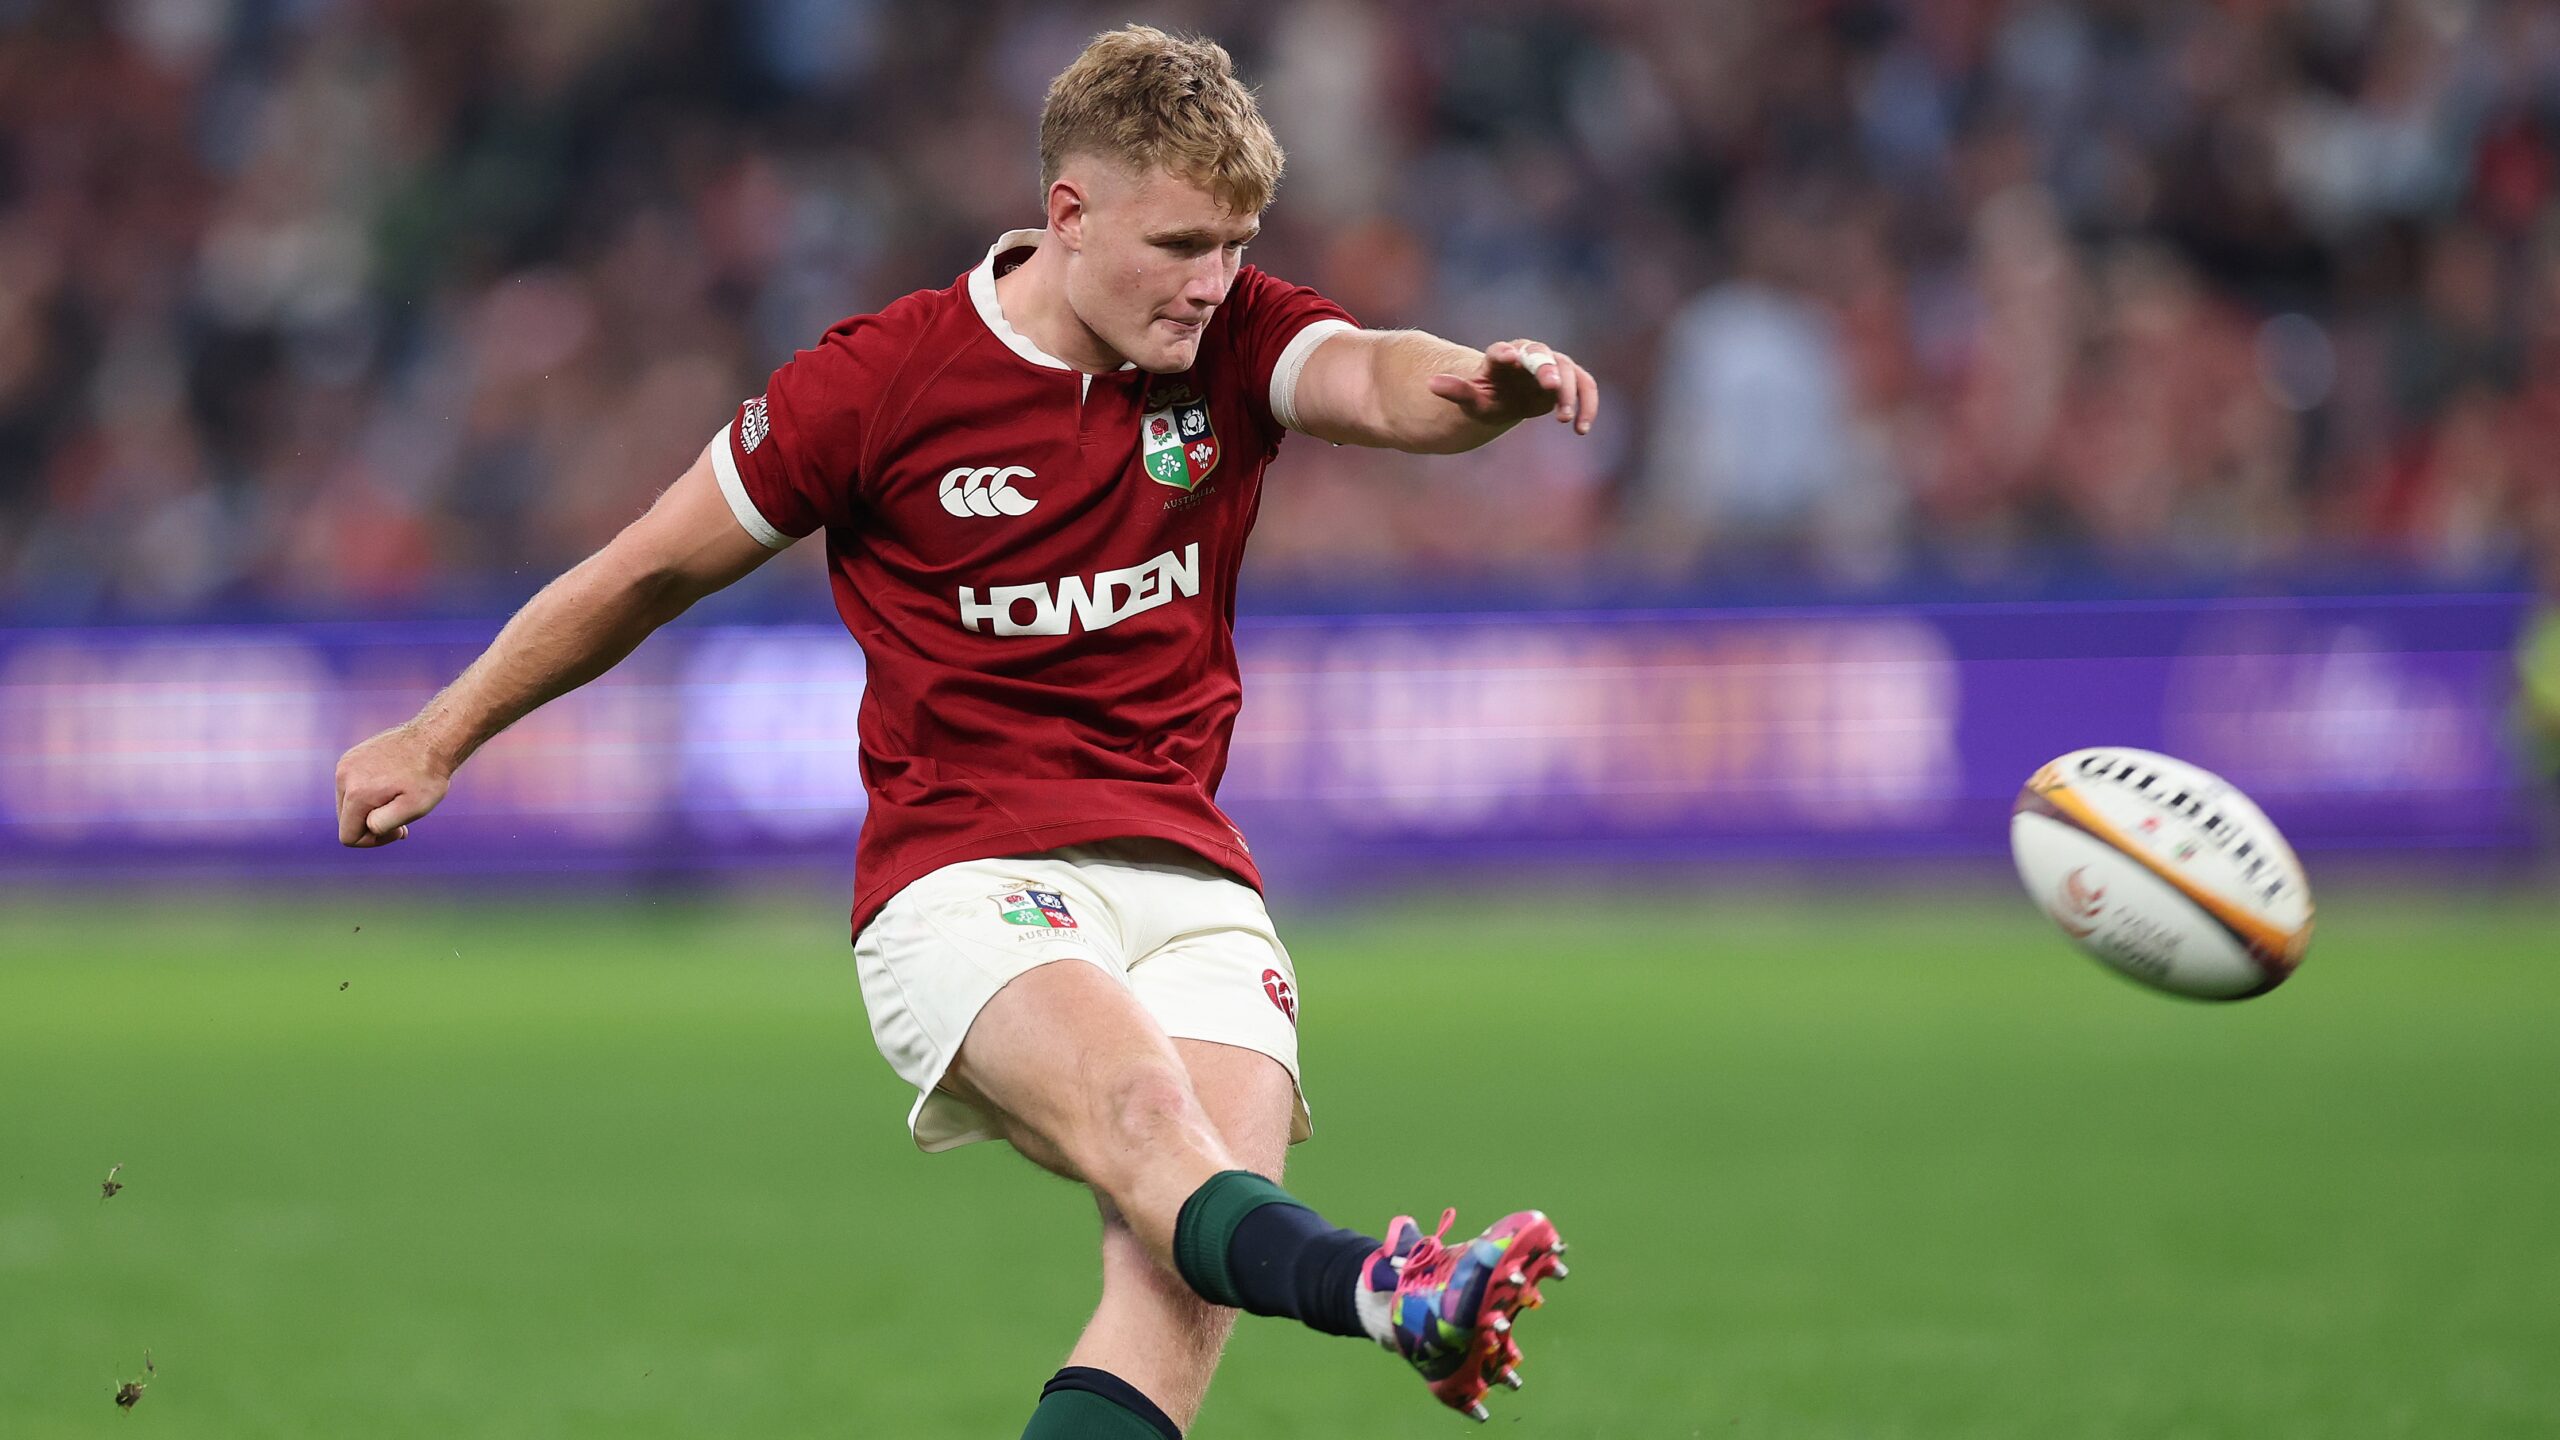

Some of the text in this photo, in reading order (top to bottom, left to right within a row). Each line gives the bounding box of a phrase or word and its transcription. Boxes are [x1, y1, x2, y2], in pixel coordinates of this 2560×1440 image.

[1162, 486, 1217, 510] AUSTRALIA
[958, 541, 1200, 637] HOWDEN
[2077, 755, 2295, 906] GILBERT
[1018, 928, 1088, 945] AUSTRALIA
